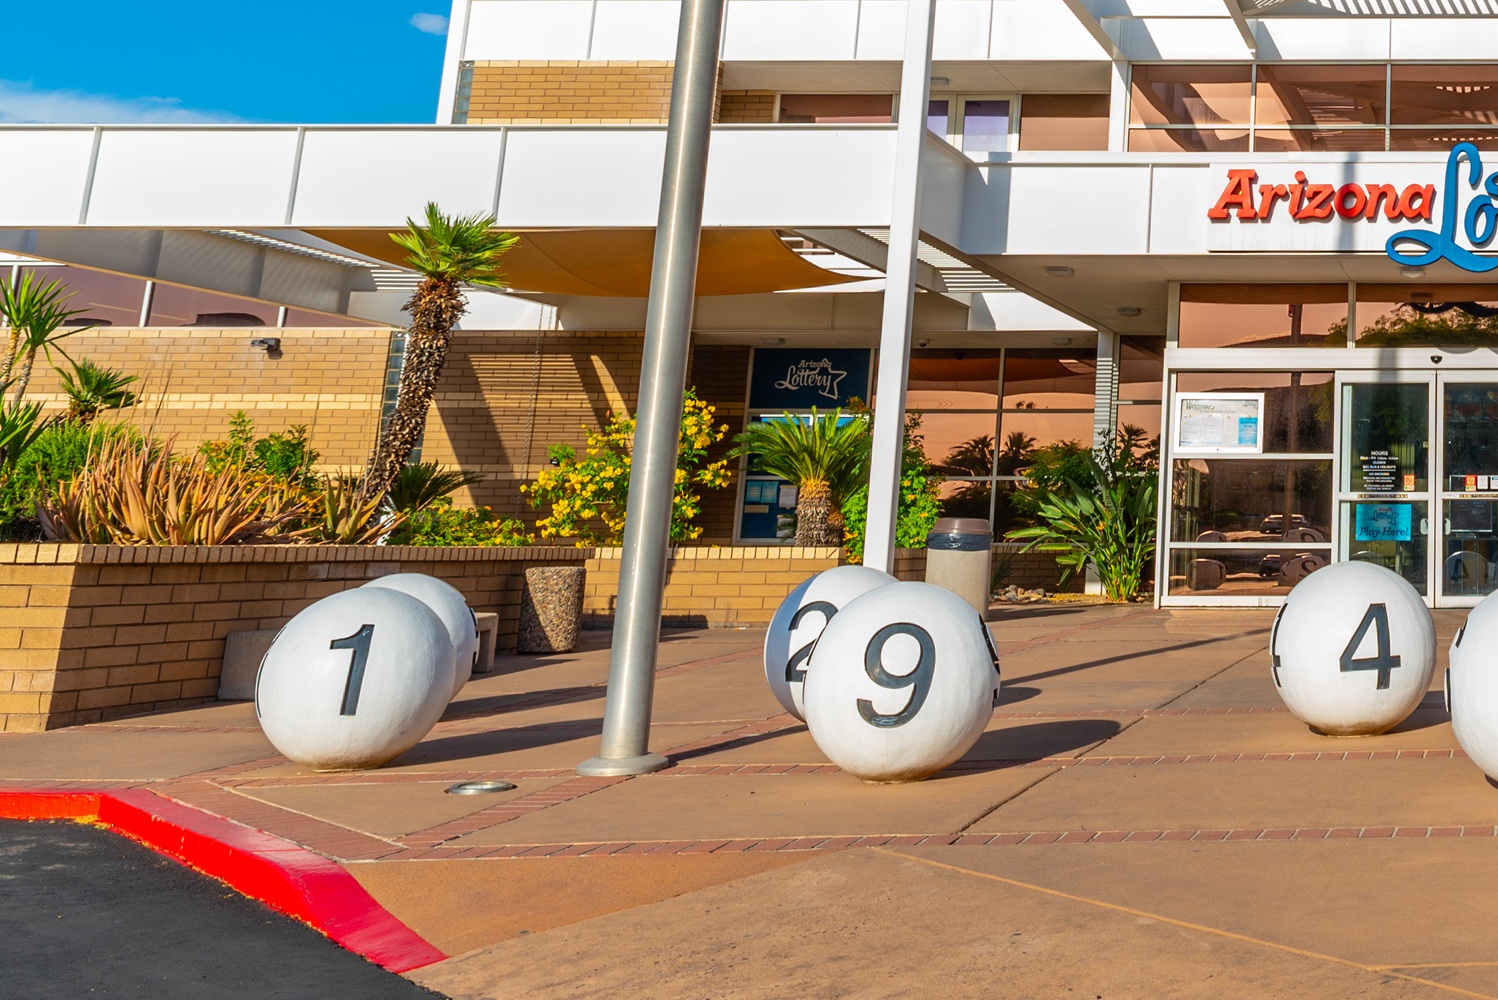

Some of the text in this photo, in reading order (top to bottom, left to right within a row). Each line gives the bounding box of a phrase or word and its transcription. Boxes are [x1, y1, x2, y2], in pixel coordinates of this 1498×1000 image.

[1208, 169, 1435, 220] Arizona
[775, 365, 838, 397] Lottery
[798, 359, 833, 369] Arizona
[1359, 526, 1409, 538] Play Here!
[329, 623, 375, 716] 1
[785, 601, 839, 682] 2
[1339, 603, 1401, 690] 4
[856, 622, 936, 729] 9
